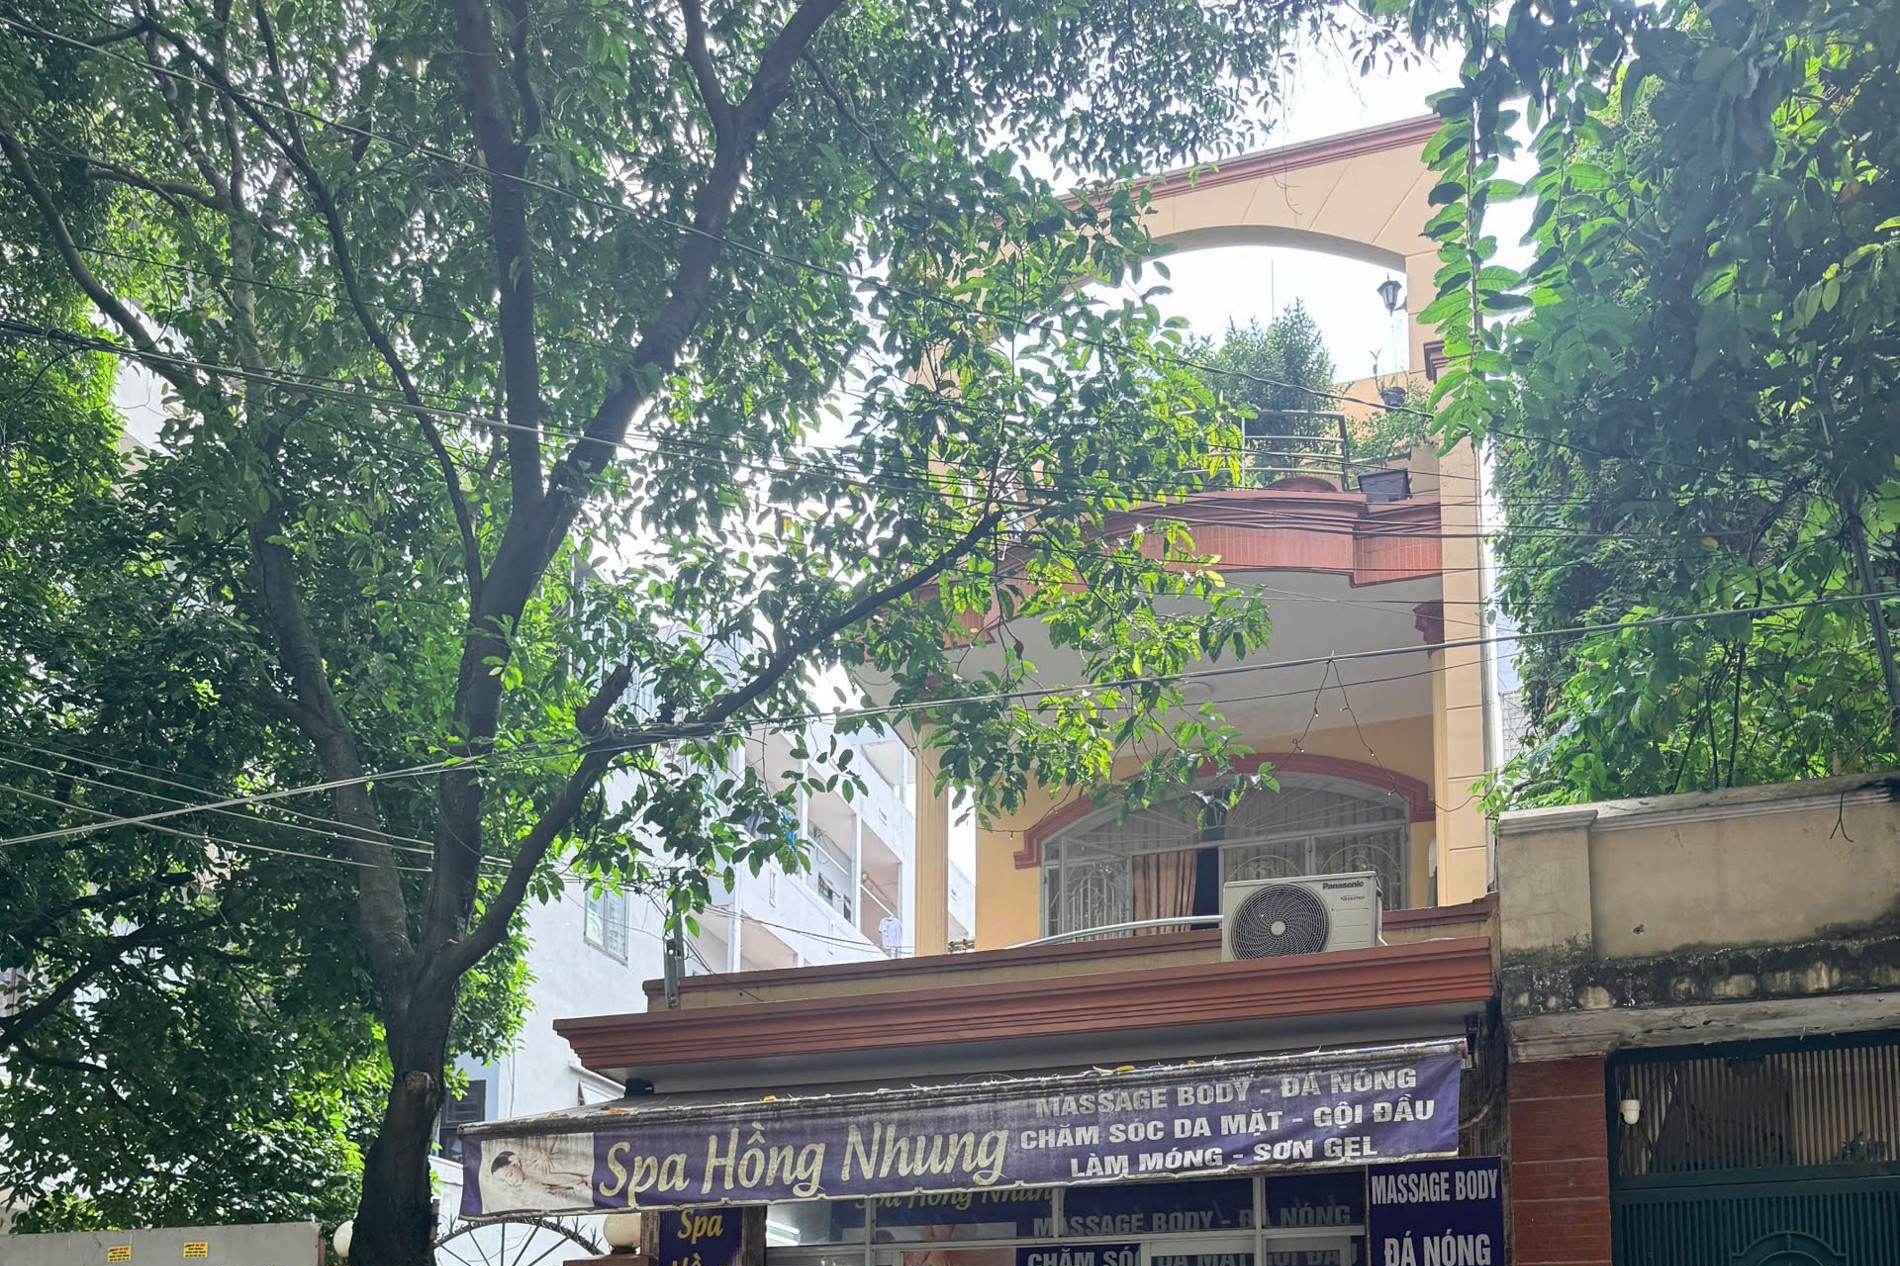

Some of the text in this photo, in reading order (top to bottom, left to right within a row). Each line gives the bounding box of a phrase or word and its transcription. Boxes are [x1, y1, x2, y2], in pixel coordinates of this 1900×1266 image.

[1323, 880, 1364, 889] Panasonic
[1036, 1087, 1168, 1117] MASSAGE
[1177, 1080, 1250, 1106] BODY
[1281, 1072, 1321, 1098] ĐÁ
[1331, 1067, 1417, 1094] NÓNG
[1020, 1123, 1100, 1149] CHĂM
[1109, 1118, 1165, 1143] SÓC
[1174, 1117, 1212, 1138] DA
[1221, 1108, 1283, 1136] MẶT
[1314, 1101, 1363, 1128] GỘI
[1372, 1094, 1435, 1122] ĐẦU
[600, 1121, 1010, 1209] Spa Hồng Nhung
[1071, 1153, 1129, 1178] LÀM
[1138, 1147, 1223, 1171] MÓNG
[1254, 1139, 1314, 1162] SƠN
[1323, 1136, 1378, 1158] GEL
[1371, 1169, 1498, 1205] MASSAGE BODY
[677, 1209, 723, 1245] Spa
[1423, 1228, 1491, 1266] NÓNG
